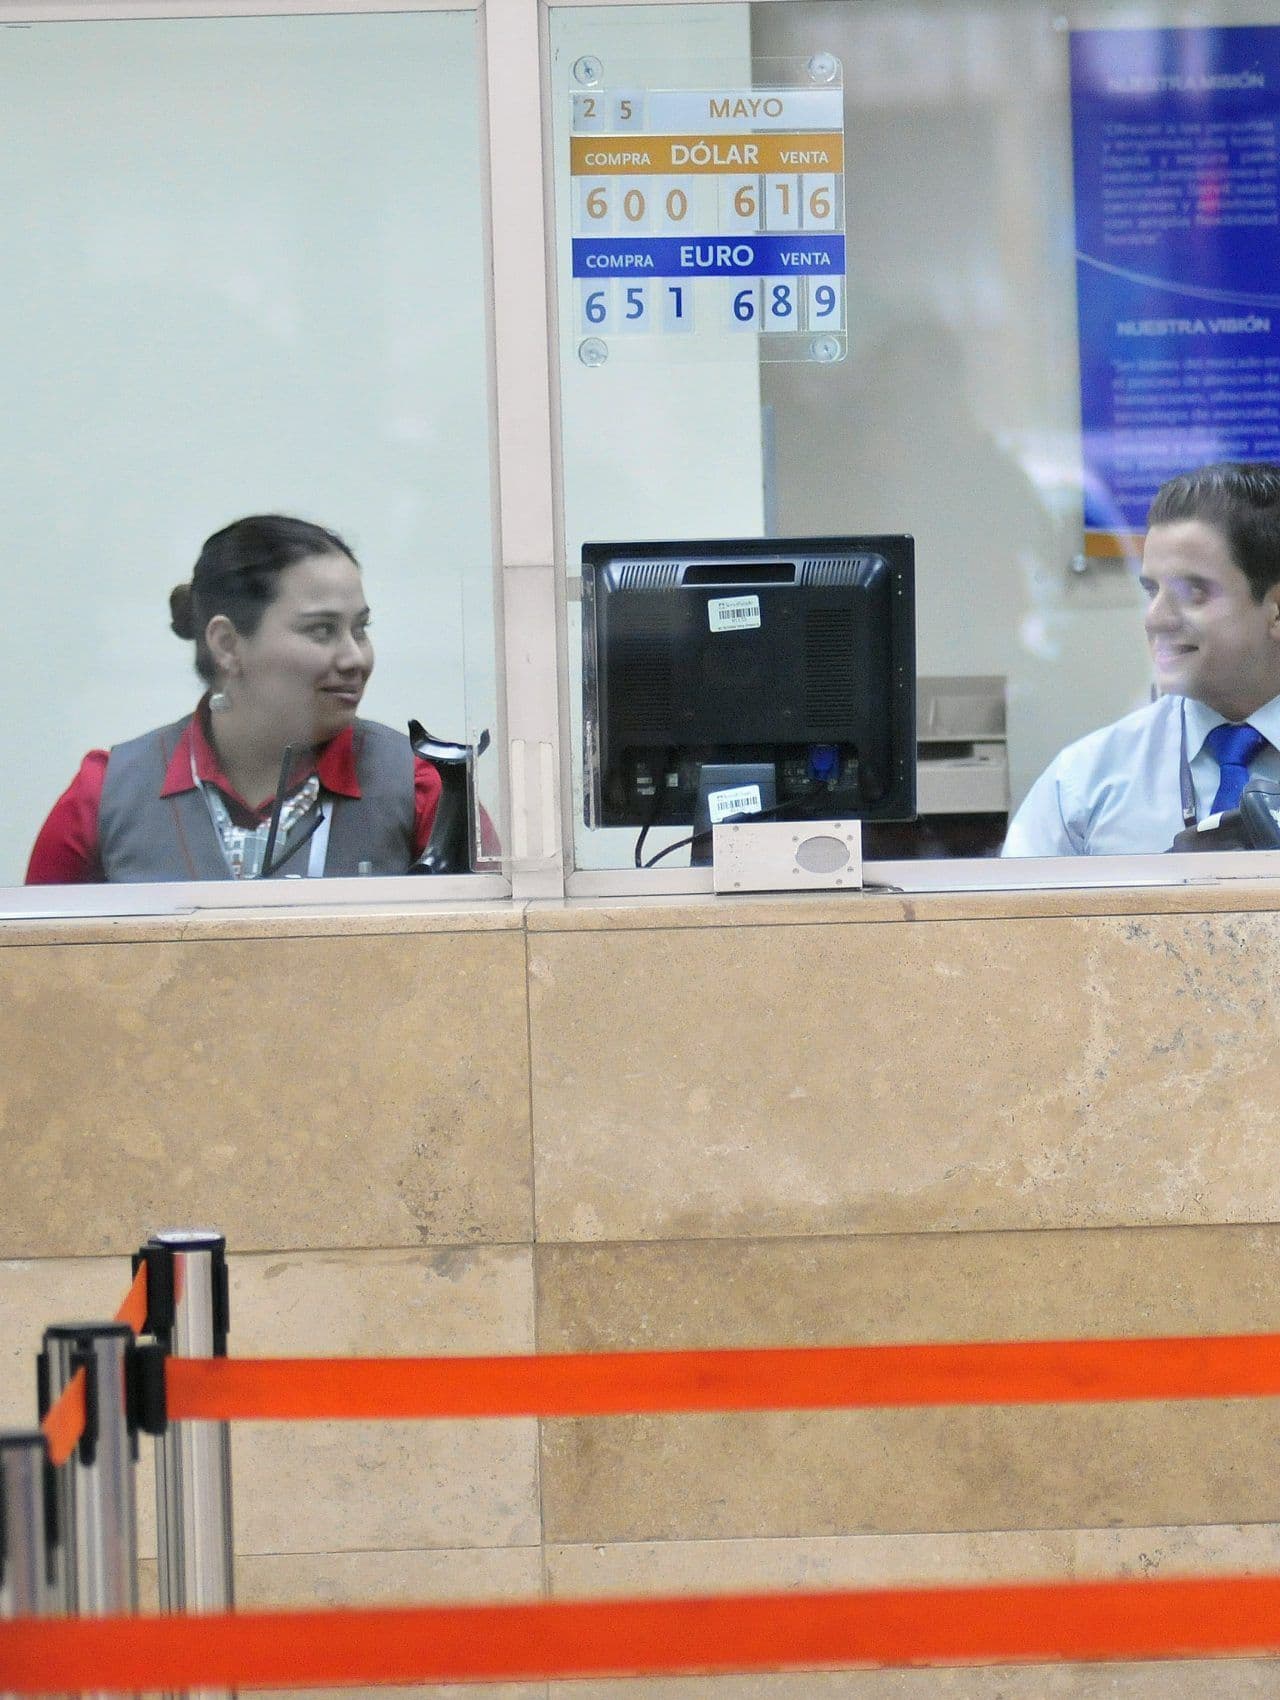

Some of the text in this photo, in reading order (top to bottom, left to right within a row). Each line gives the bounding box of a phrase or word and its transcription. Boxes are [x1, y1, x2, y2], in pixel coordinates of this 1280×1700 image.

[709, 99, 783, 118] MAYO
[585, 141, 829, 165] COMPRA DÓLAR VENTA
[586, 246, 831, 268] COMPRA EURO VENTA
[1117, 315, 1271, 337] NUESTRA VISIÓN
